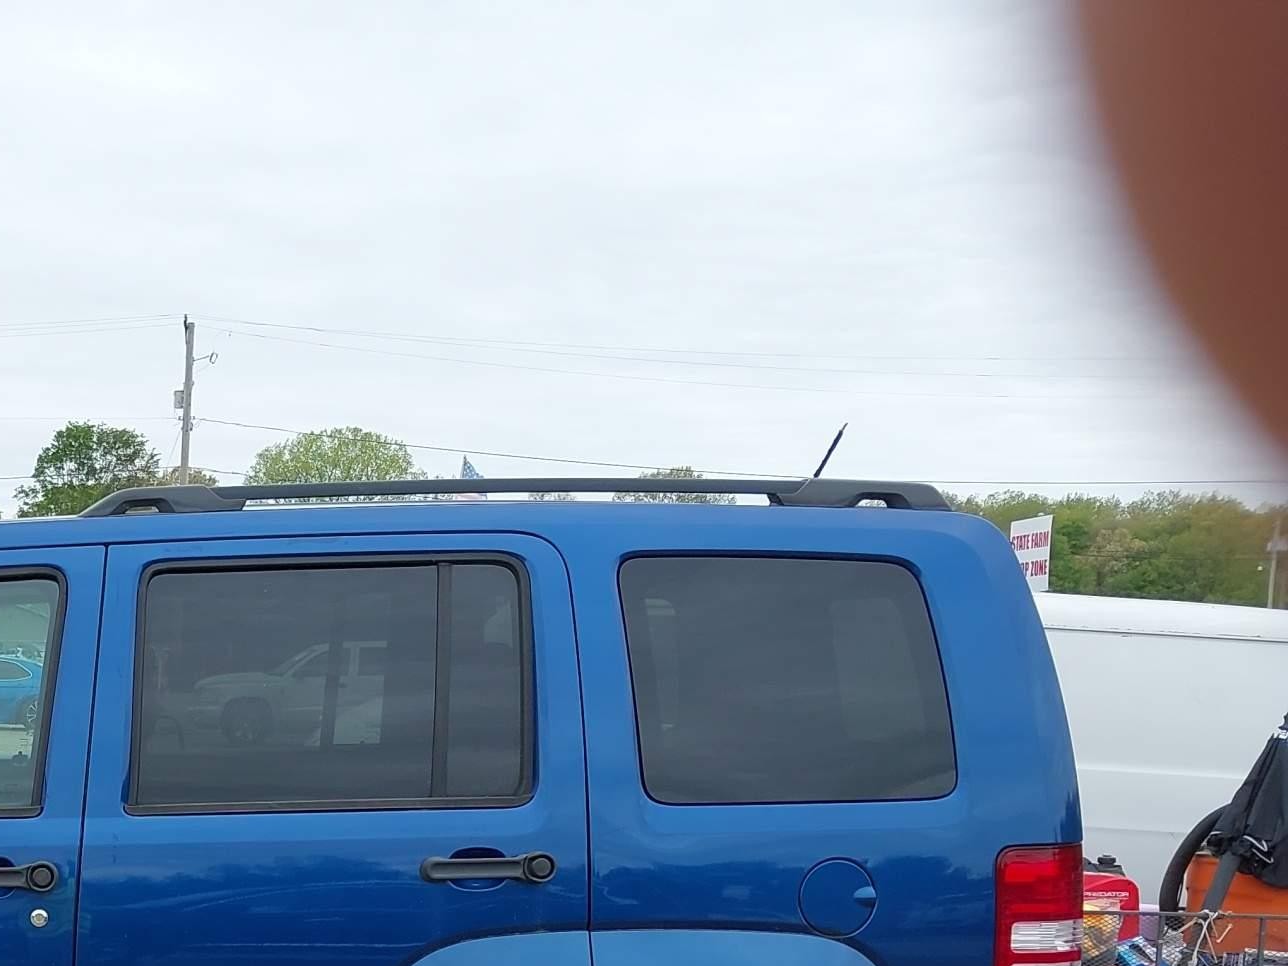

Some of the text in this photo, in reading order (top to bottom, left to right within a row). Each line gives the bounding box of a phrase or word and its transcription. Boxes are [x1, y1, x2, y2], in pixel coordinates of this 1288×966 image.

[1012, 530, 1050, 552] STATE FARM
[1031, 559, 1048, 577] ZONE
